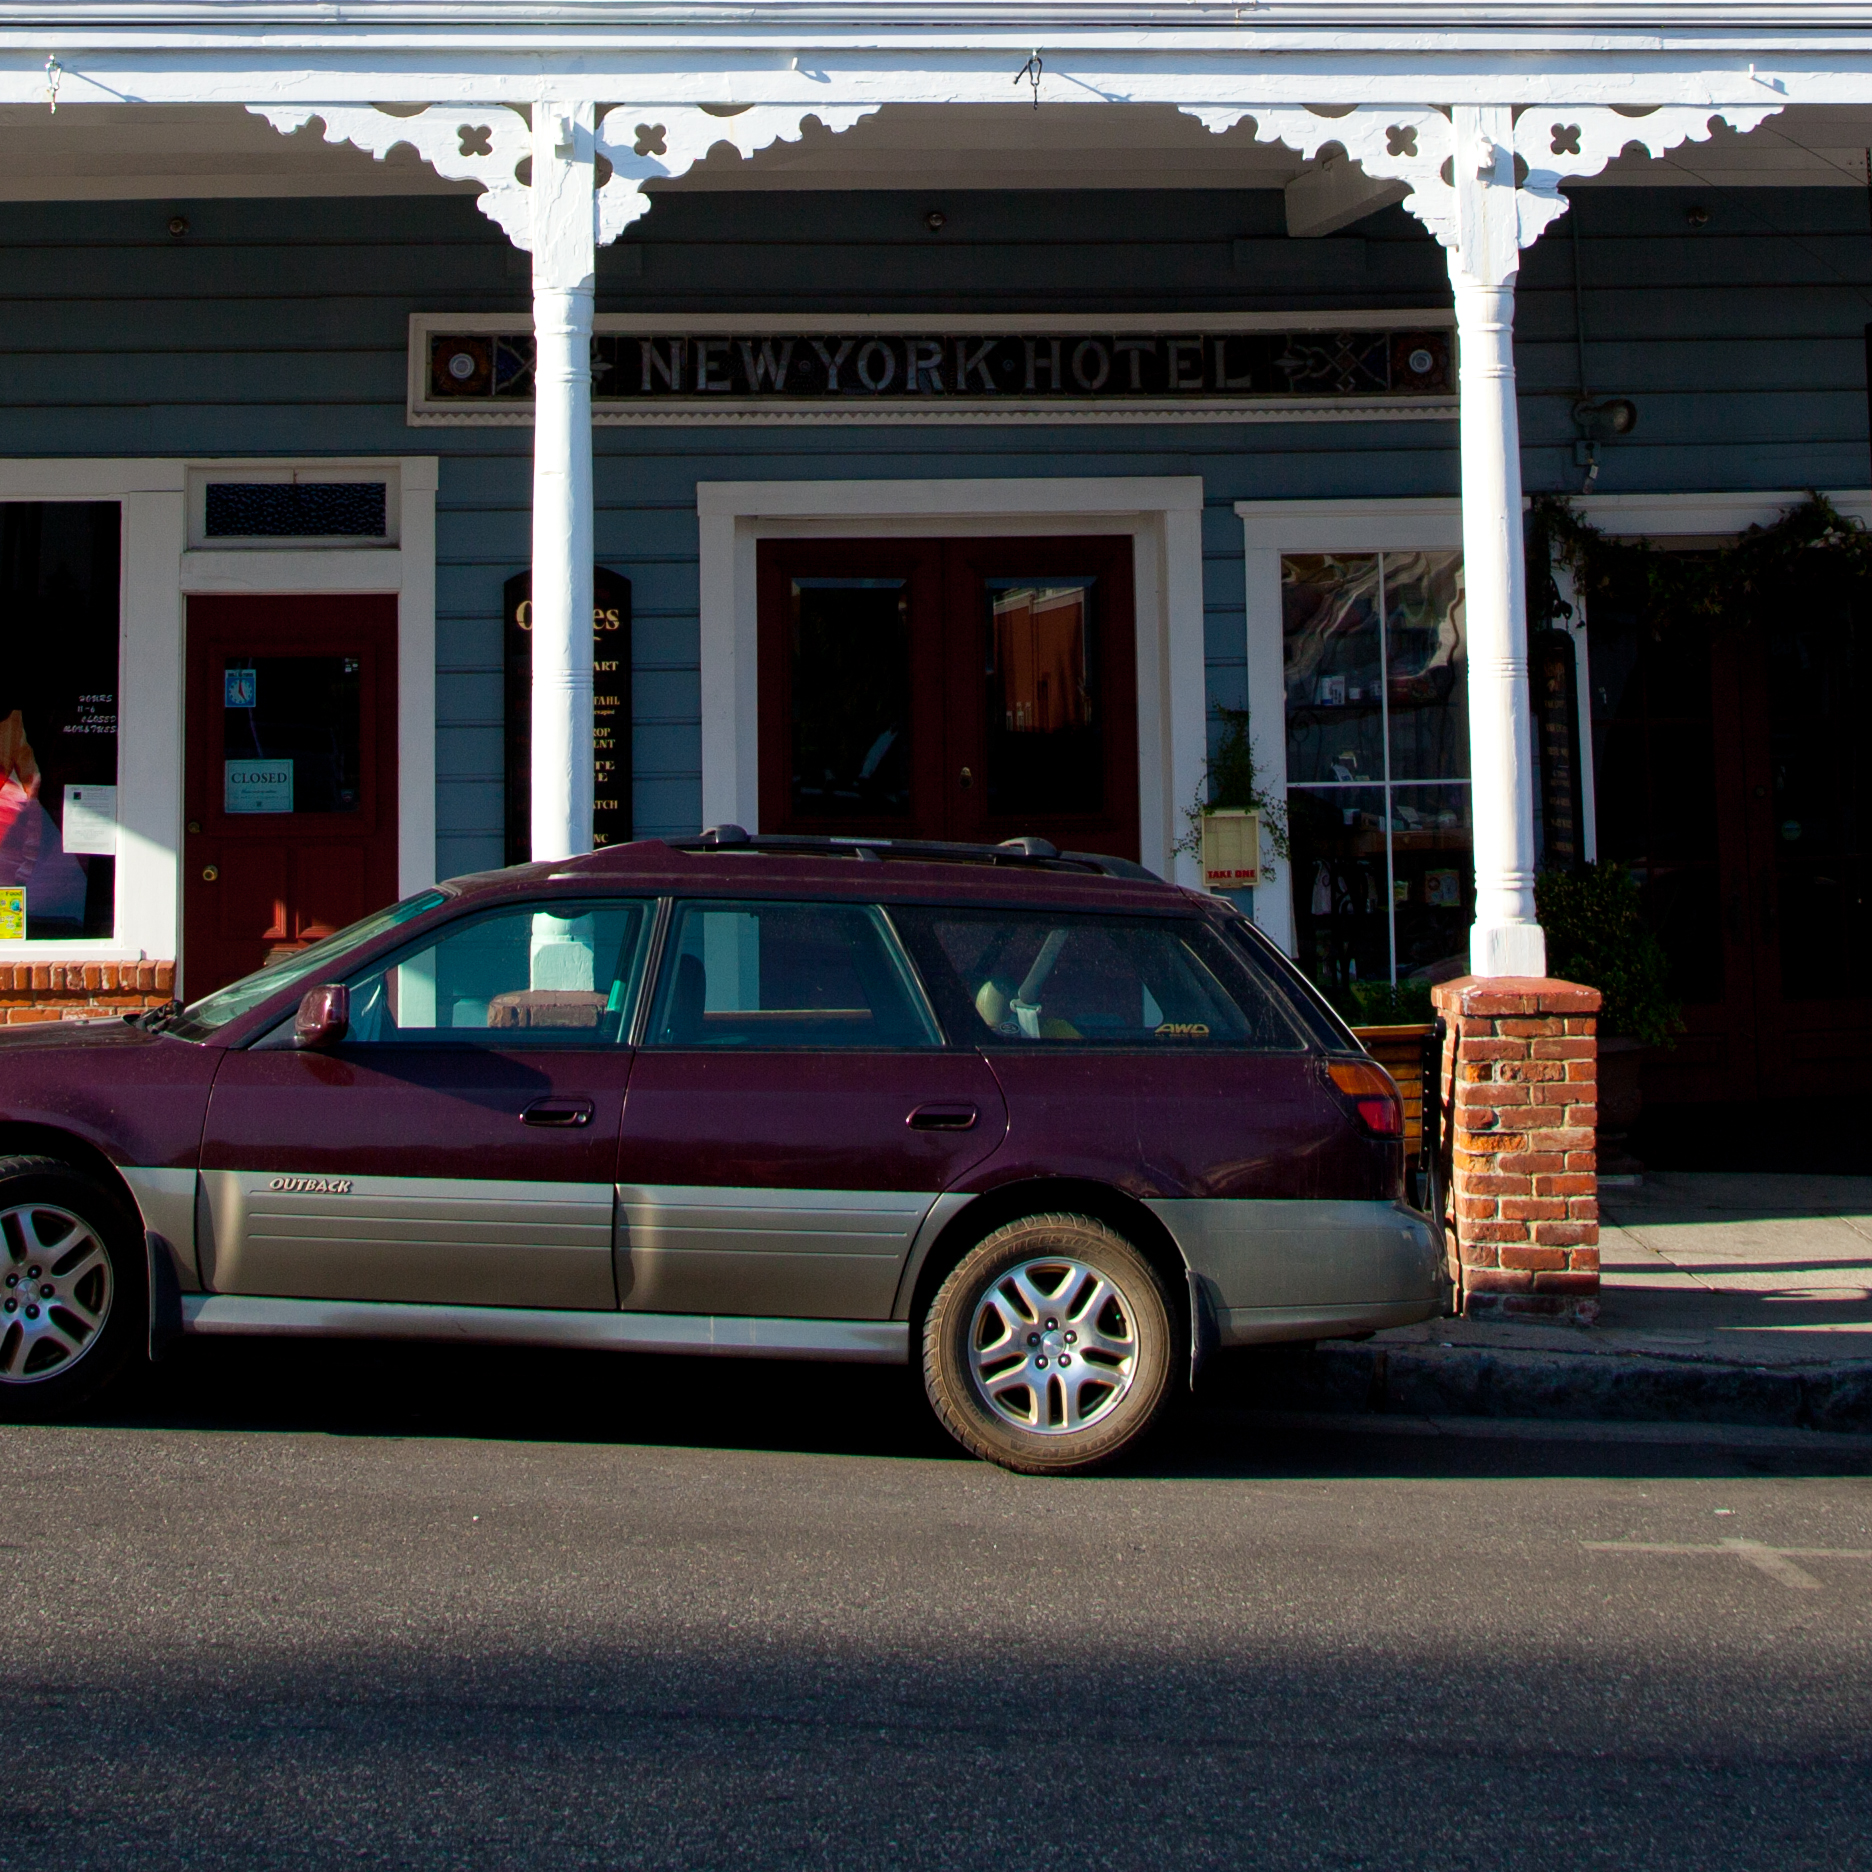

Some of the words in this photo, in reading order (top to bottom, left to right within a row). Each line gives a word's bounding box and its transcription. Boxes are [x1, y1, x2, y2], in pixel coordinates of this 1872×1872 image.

[639, 336, 795, 392] NEW
[818, 336, 996, 392] YORK
[1026, 335, 1254, 391] HOTEL
[231, 772, 288, 784] CLOSED
[1208, 870, 1232, 879] TAKE
[1235, 869, 1255, 878] ONE
[1155, 1023, 1210, 1034] AWD
[269, 1177, 352, 1194] OUTBACK
